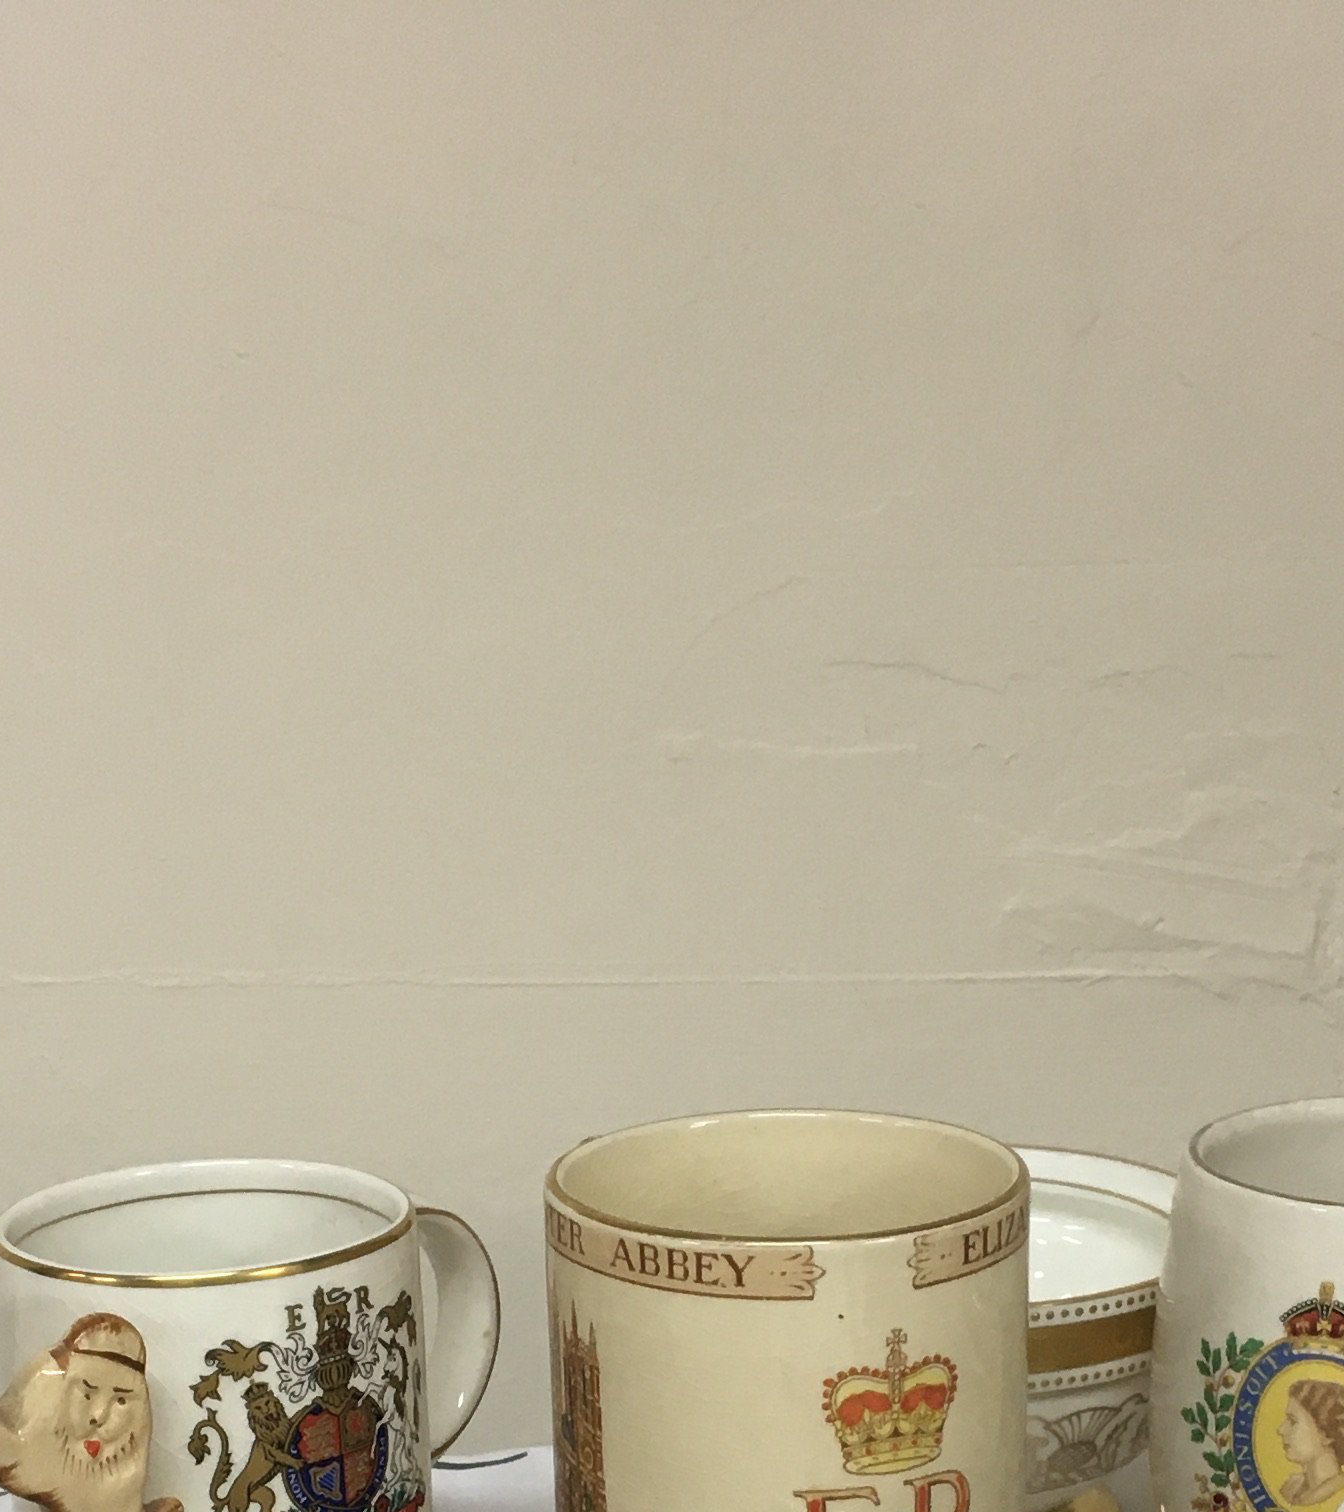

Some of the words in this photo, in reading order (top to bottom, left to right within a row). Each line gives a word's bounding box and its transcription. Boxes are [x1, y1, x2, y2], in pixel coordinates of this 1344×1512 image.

[610, 1237, 756, 1288] ABBEY
[285, 1303, 307, 1333] E
[354, 1285, 374, 1314] R
